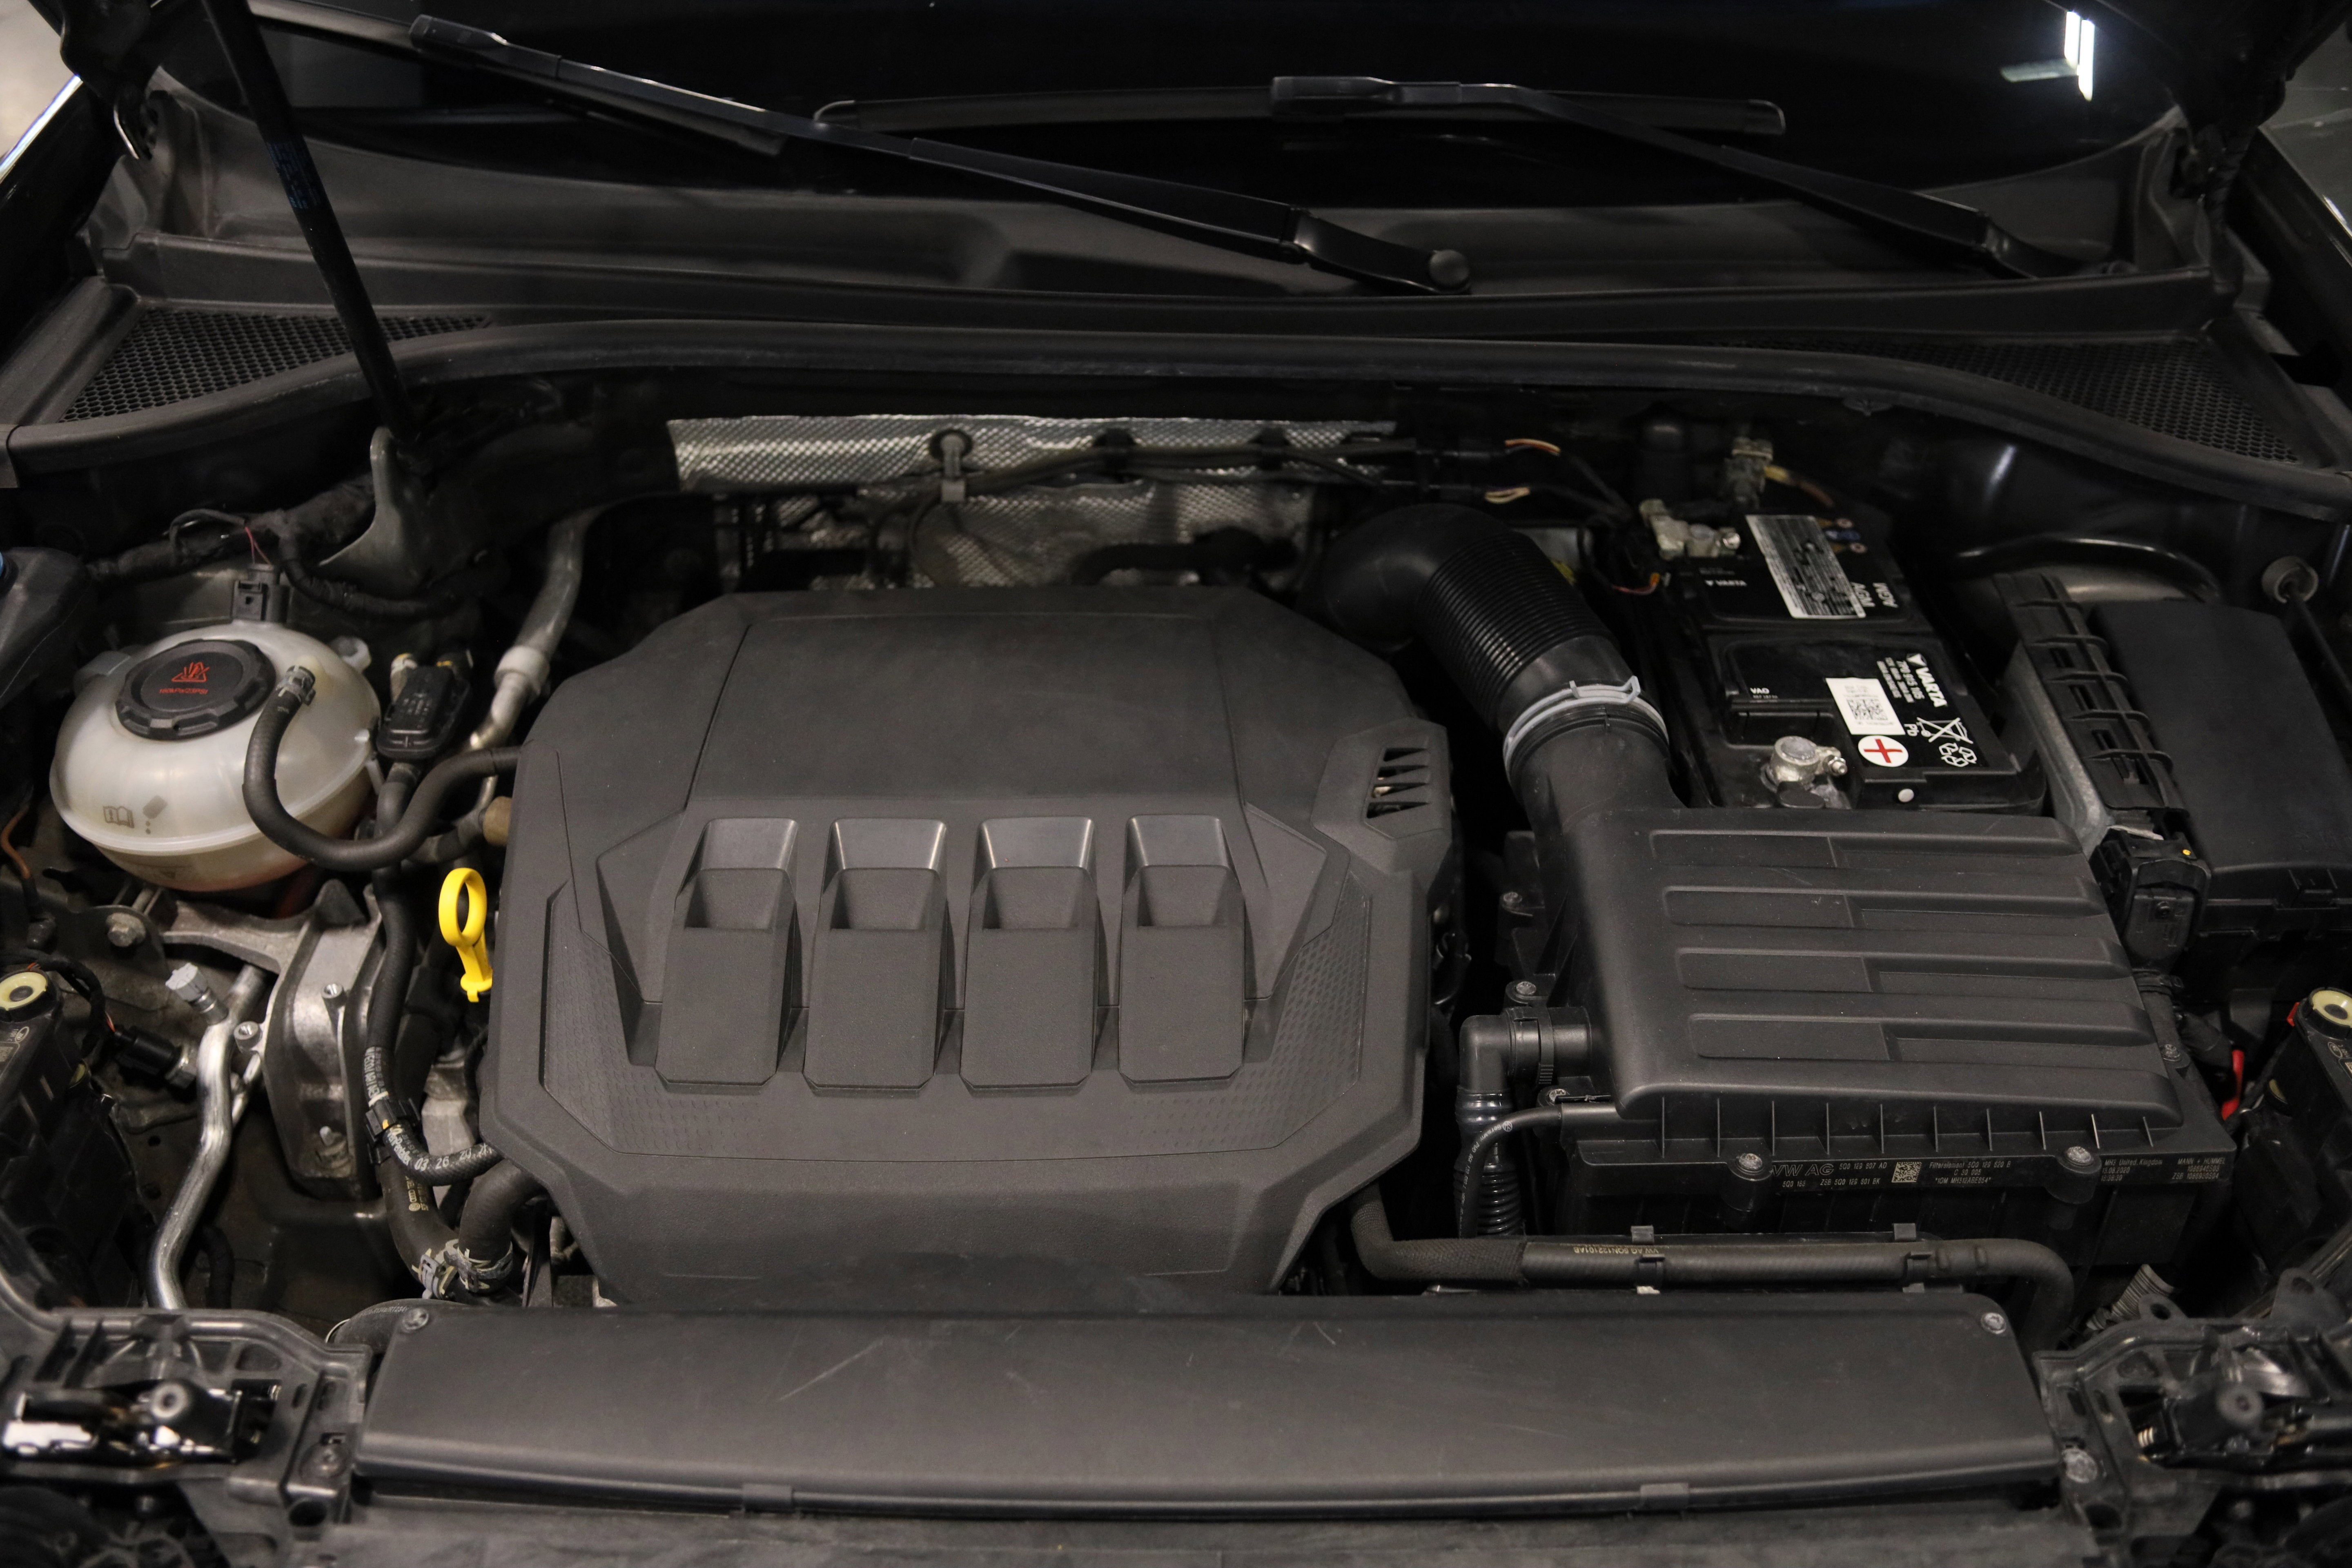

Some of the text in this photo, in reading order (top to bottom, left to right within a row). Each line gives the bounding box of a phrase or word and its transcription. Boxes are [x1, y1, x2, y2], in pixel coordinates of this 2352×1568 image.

[1915, 666, 1947, 707] VARTA
[1904, 723, 1920, 737] Pb
[1479, 1124, 1501, 1141] Germany
[1773, 1163, 1834, 1176] VW AG
